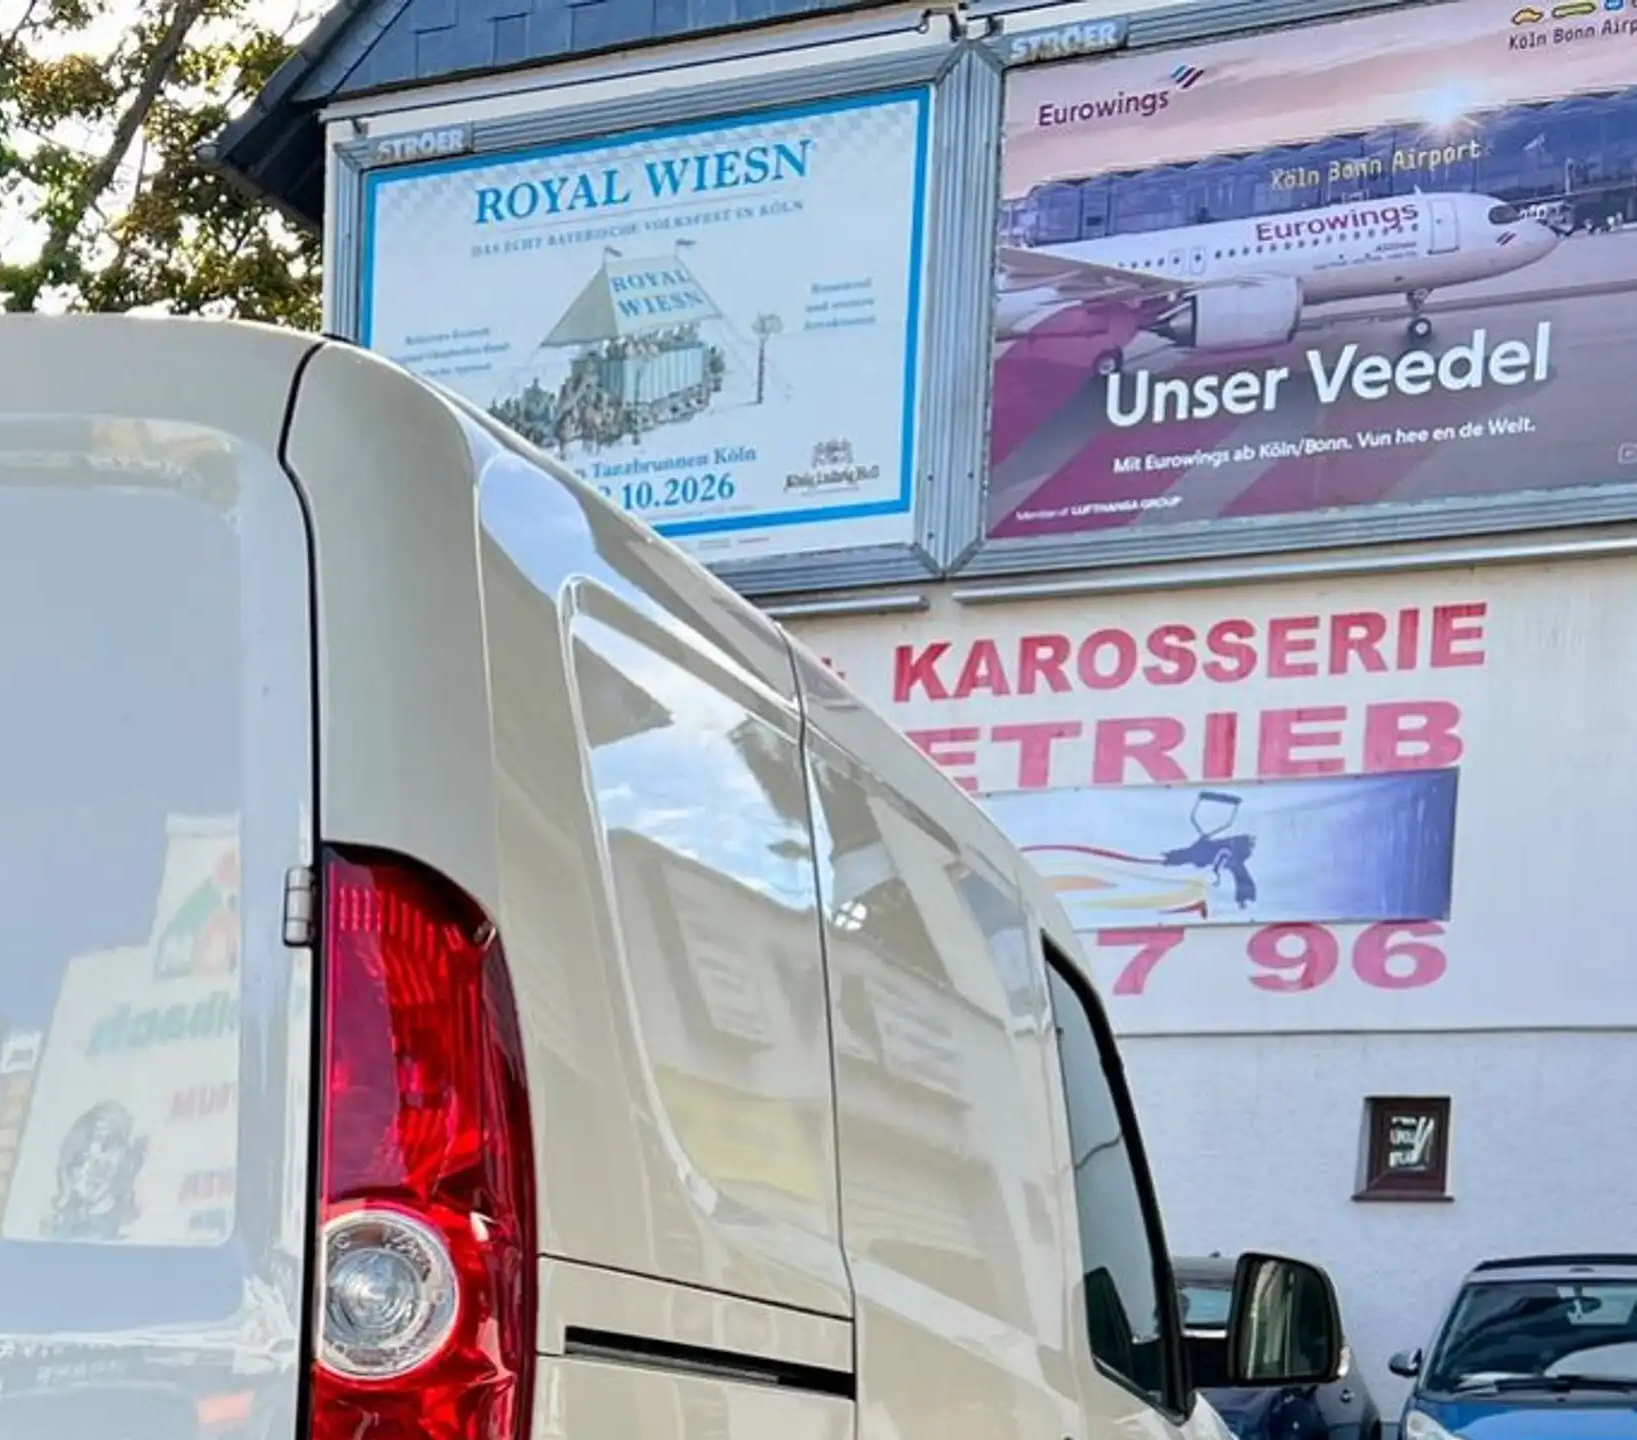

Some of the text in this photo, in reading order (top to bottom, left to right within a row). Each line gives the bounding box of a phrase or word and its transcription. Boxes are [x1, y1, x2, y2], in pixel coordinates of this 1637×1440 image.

[1509, 32, 1547, 50] Köln
[1553, 25, 1595, 44] Bonn
[1037, 88, 1170, 127] Eurowings
[474, 138, 812, 225] ROYAL WIESN
[1271, 139, 1482, 190] Köln Bonn Airport
[1255, 201, 1419, 244] Eurowings
[610, 268, 693, 293] ROYAL
[617, 291, 704, 318] WIESN
[1106, 321, 1552, 427] Unser Veedel
[592, 454, 708, 478] Tanzbrunnen
[714, 446, 756, 465] Köln
[1113, 415, 1536, 475] Mit Eurowings ab Köln/Bonn. Vun hee en de Welt.
[892, 602, 1488, 703] KAROSSERIE
[1096, 920, 1448, 996] 7 96
